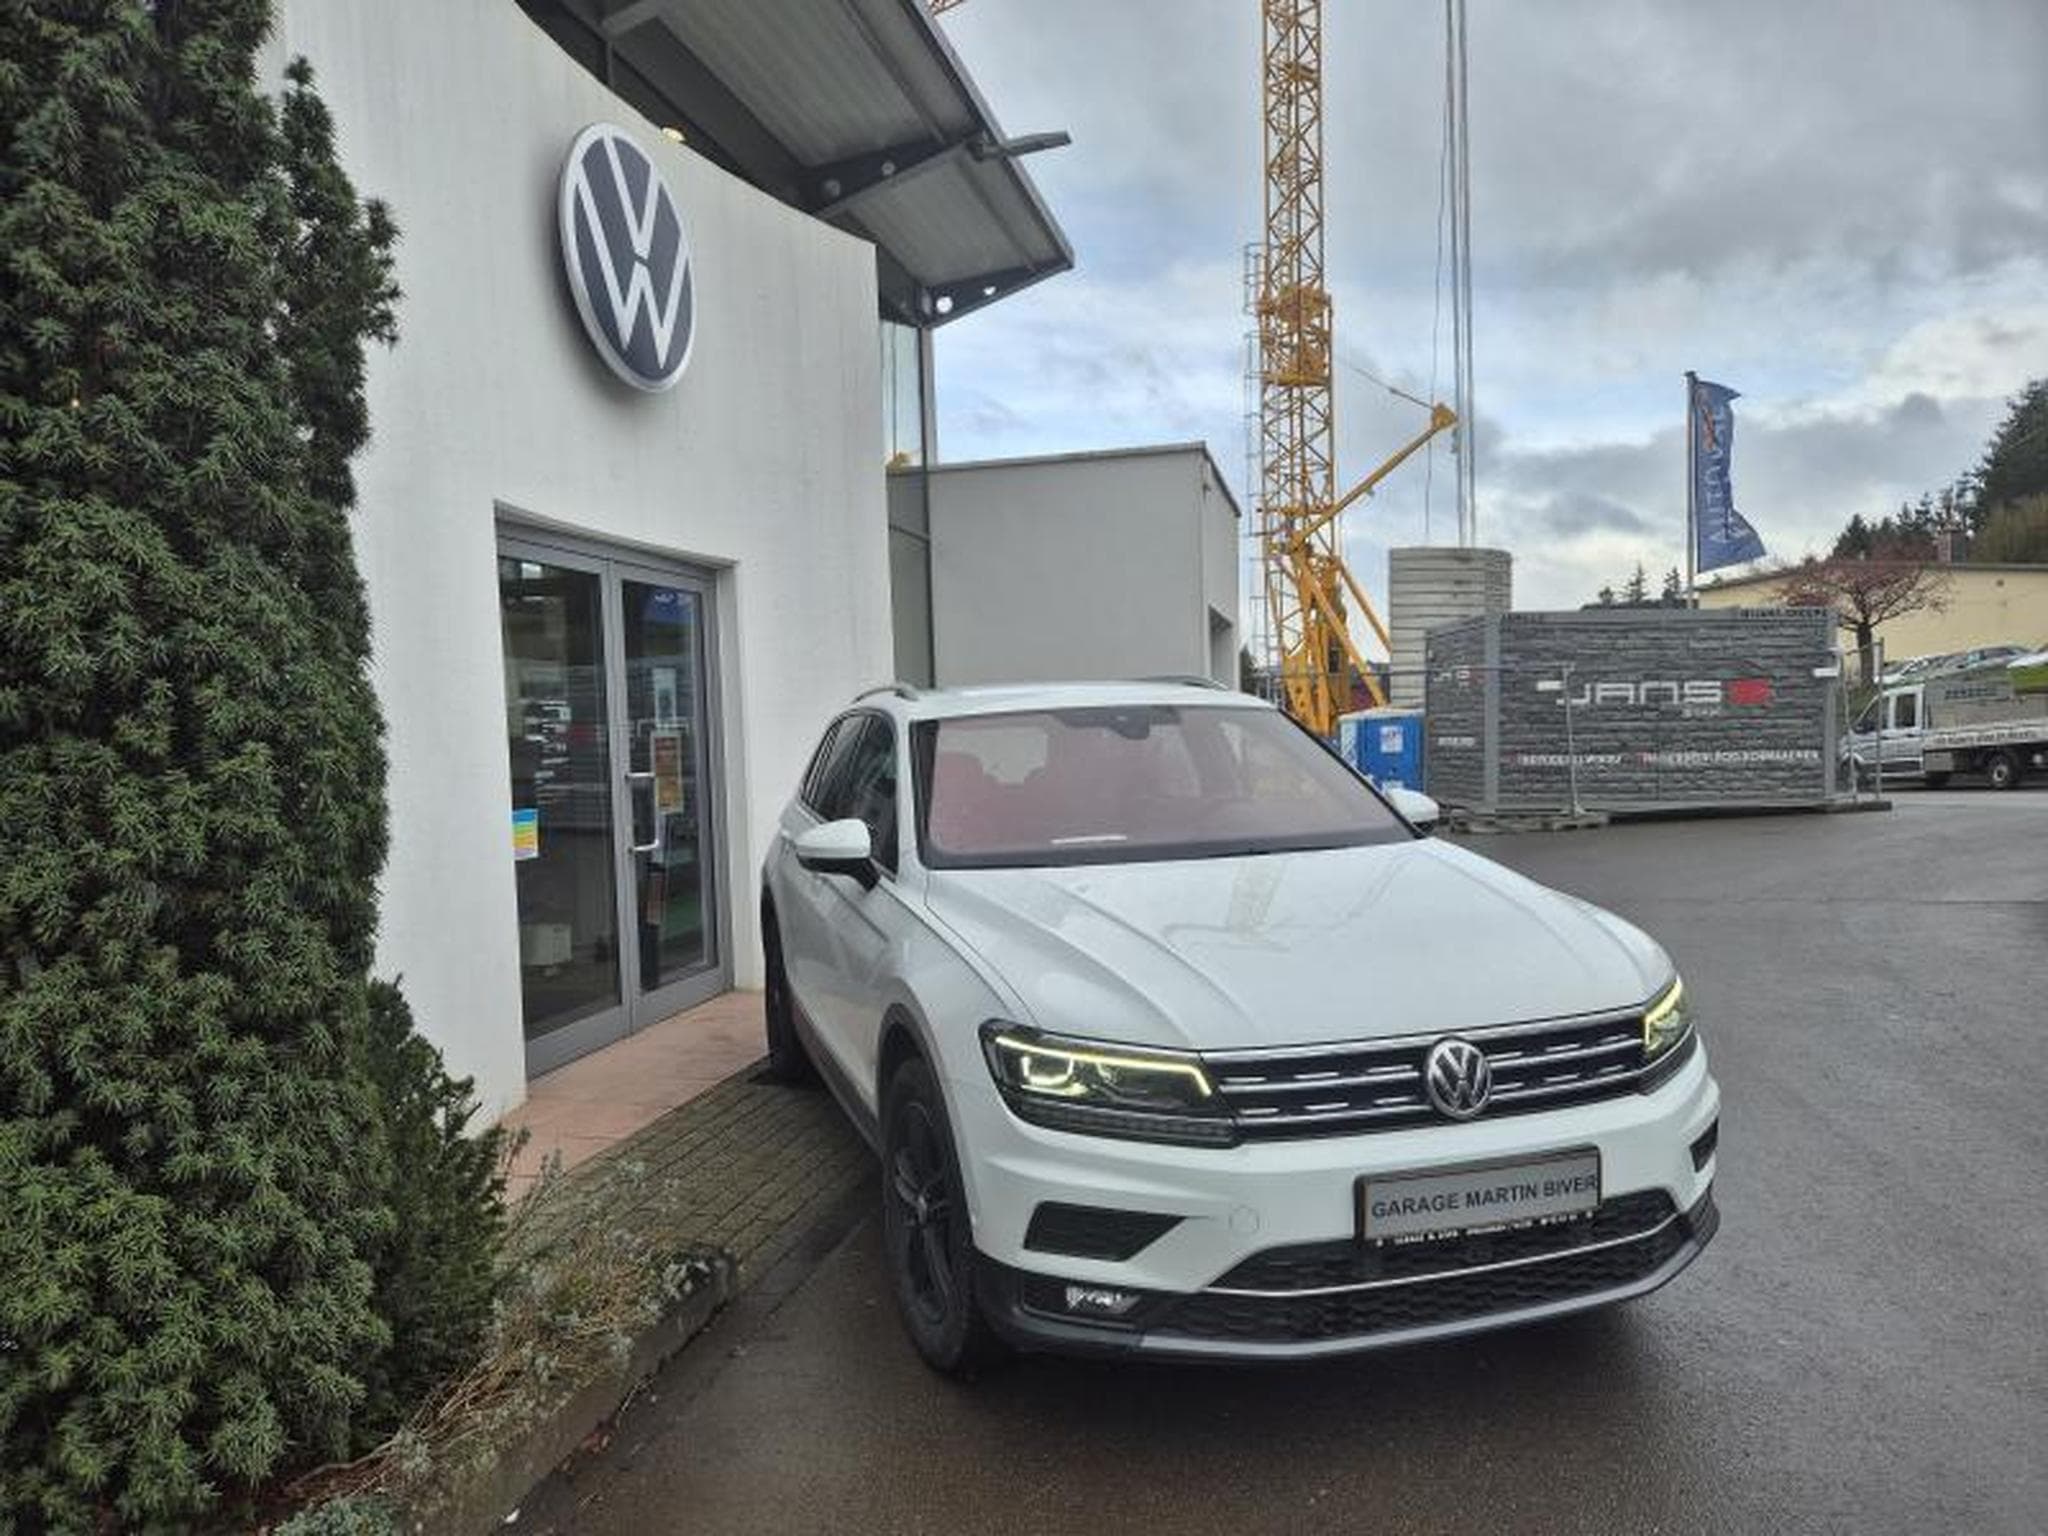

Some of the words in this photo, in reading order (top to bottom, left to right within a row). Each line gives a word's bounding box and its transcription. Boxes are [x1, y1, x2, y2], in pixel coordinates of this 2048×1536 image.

[1371, 1194, 1460, 1219] GARAGE
[1465, 1181, 1538, 1209] MARTIN
[1543, 1174, 1599, 1197] BIVER
